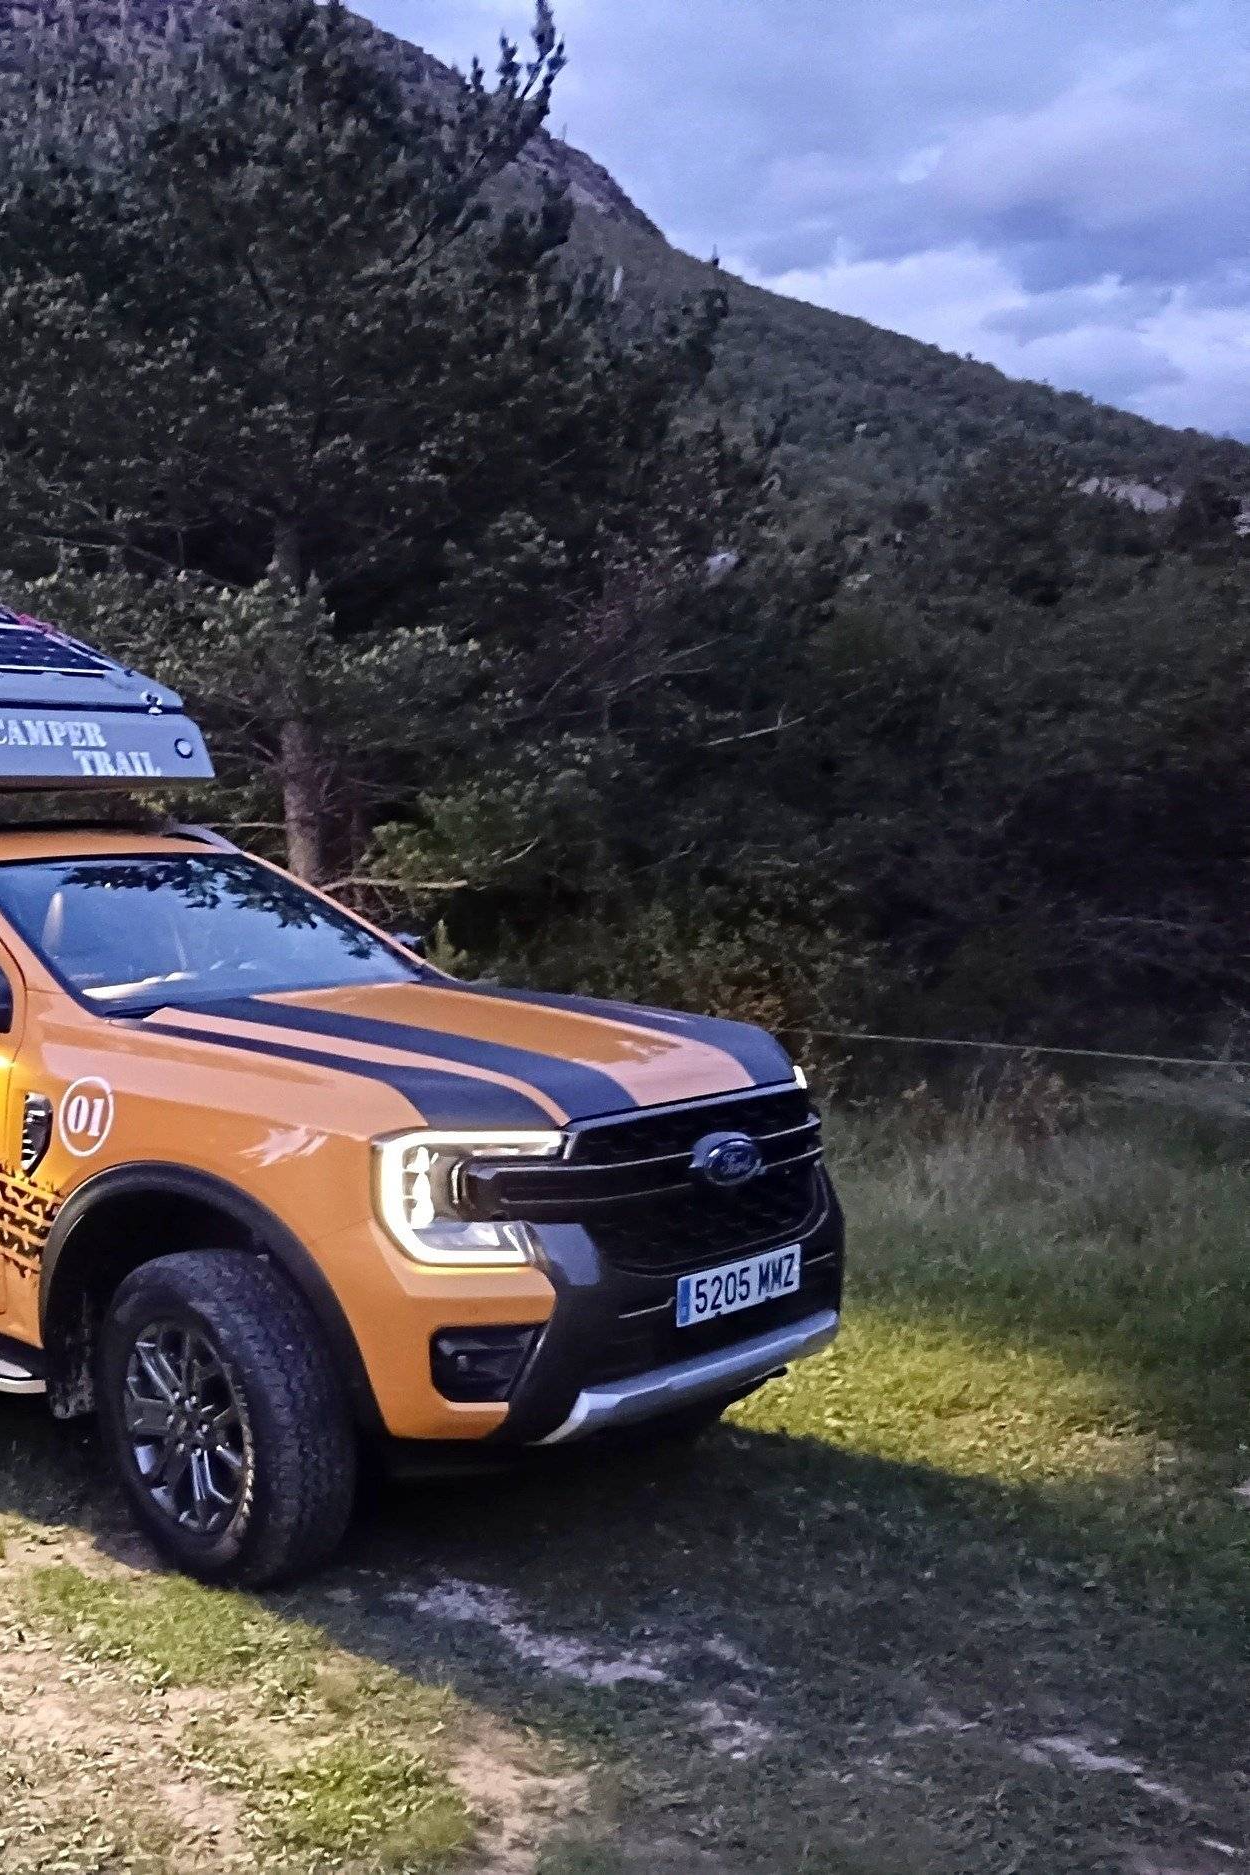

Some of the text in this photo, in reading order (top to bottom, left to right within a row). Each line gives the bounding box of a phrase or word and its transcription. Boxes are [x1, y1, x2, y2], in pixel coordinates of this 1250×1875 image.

[72, 751, 162, 778] TRAIL
[67, 1095, 105, 1138] 01
[695, 1253, 795, 1314] 5205 MMZ
